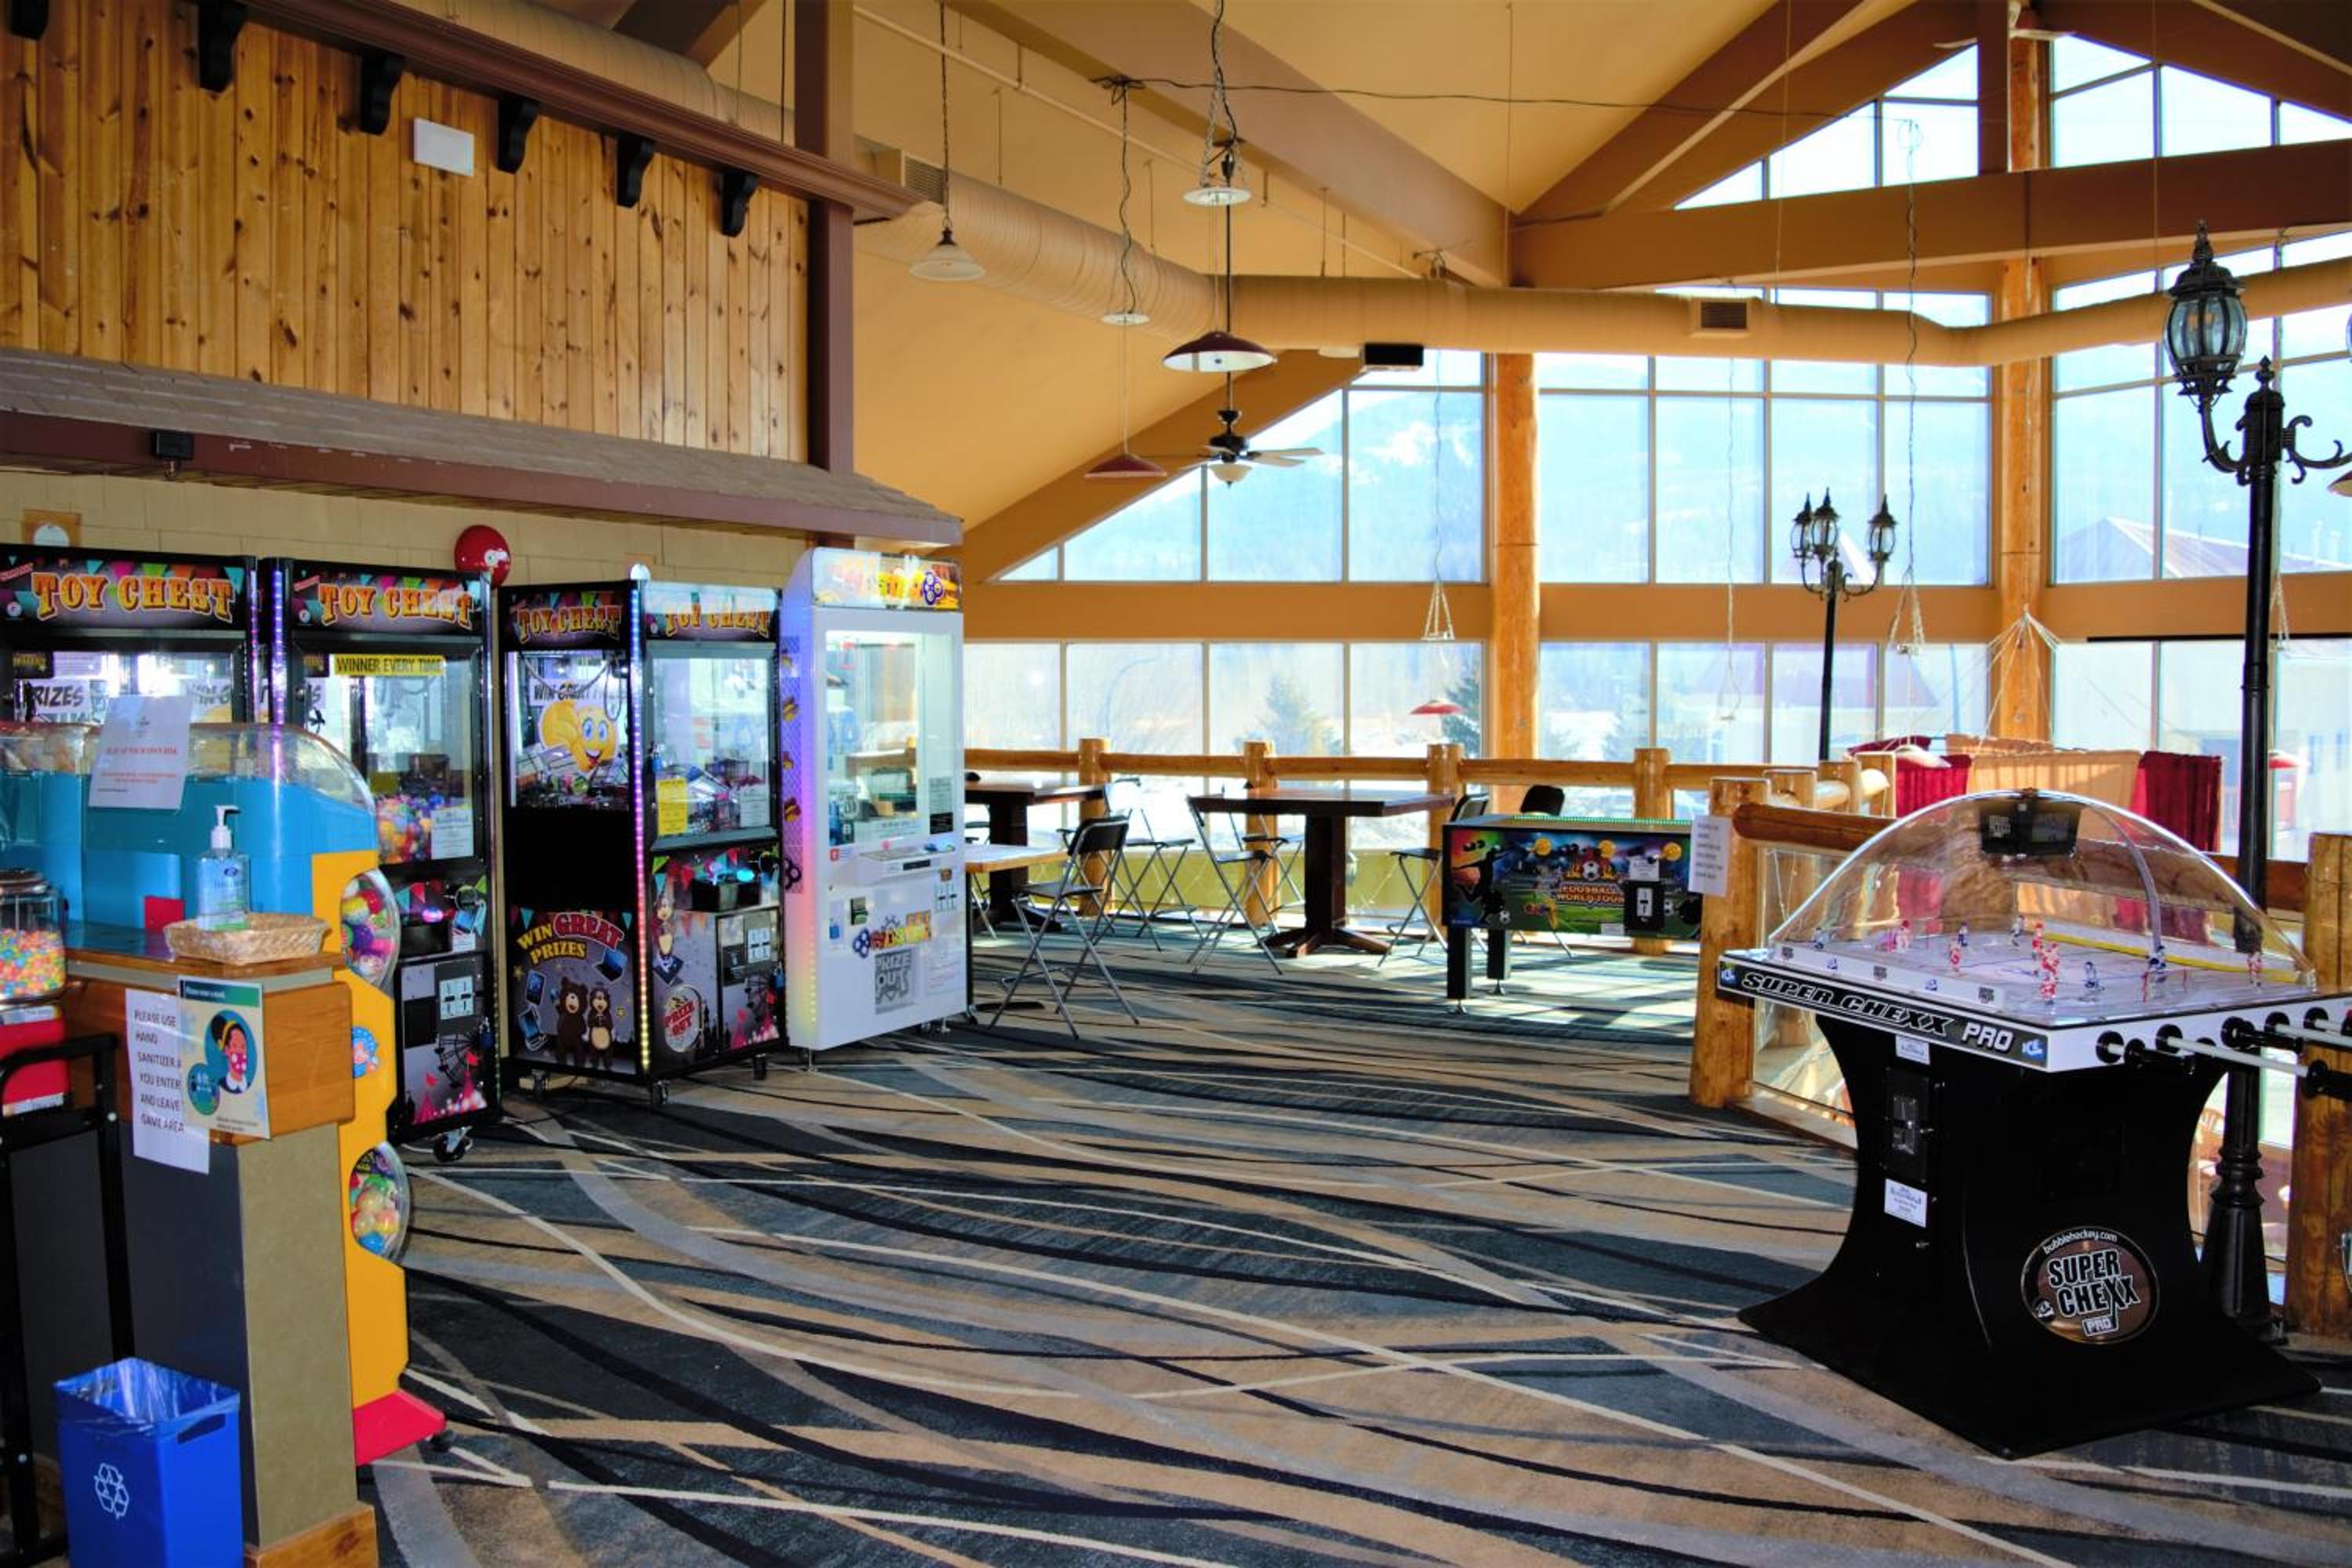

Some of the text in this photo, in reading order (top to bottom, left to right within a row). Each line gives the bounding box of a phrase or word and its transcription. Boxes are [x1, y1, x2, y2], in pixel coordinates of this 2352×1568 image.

[31, 572, 234, 622] TOY CHEST
[318, 583, 474, 630] TOY CHEST
[517, 604, 622, 643] TOY CHEST
[665, 602, 770, 638] TOY CHEST
[336, 658, 380, 672] WINNER
[383, 658, 415, 672] EVERY
[418, 658, 441, 673] TIME
[30, 684, 84, 707] RIZES
[1555, 894, 1594, 902] WORLD
[1561, 884, 1617, 894] FOOSBALL
[515, 924, 552, 951] WIN
[554, 912, 624, 952] GREAT
[528, 941, 586, 966] PRIZES
[876, 953, 911, 971] PRIZE
[134, 1009, 176, 1028] PLEASE USE
[664, 1001, 695, 1028] PRIZE
[1741, 972, 1833, 1005] SUPER
[1839, 994, 1954, 1038] CHEXX
[1961, 1022, 2014, 1052] PRO
[671, 1015, 691, 1036] OUT
[136, 1031, 158, 1044] HAND
[137, 1051, 176, 1068] SANITIZER
[140, 1072, 155, 1086] YOU
[156, 1077, 181, 1091] ENTER
[140, 1094, 181, 1112] AND LEAVE
[141, 1113, 185, 1134] GAME AREA
[2042, 1229, 2118, 1254] bubblehockey.com
[2047, 1248, 2122, 1288] SUPER
[2057, 1276, 2141, 1330] CHEXX
[2086, 1318, 2112, 1332] PRO
